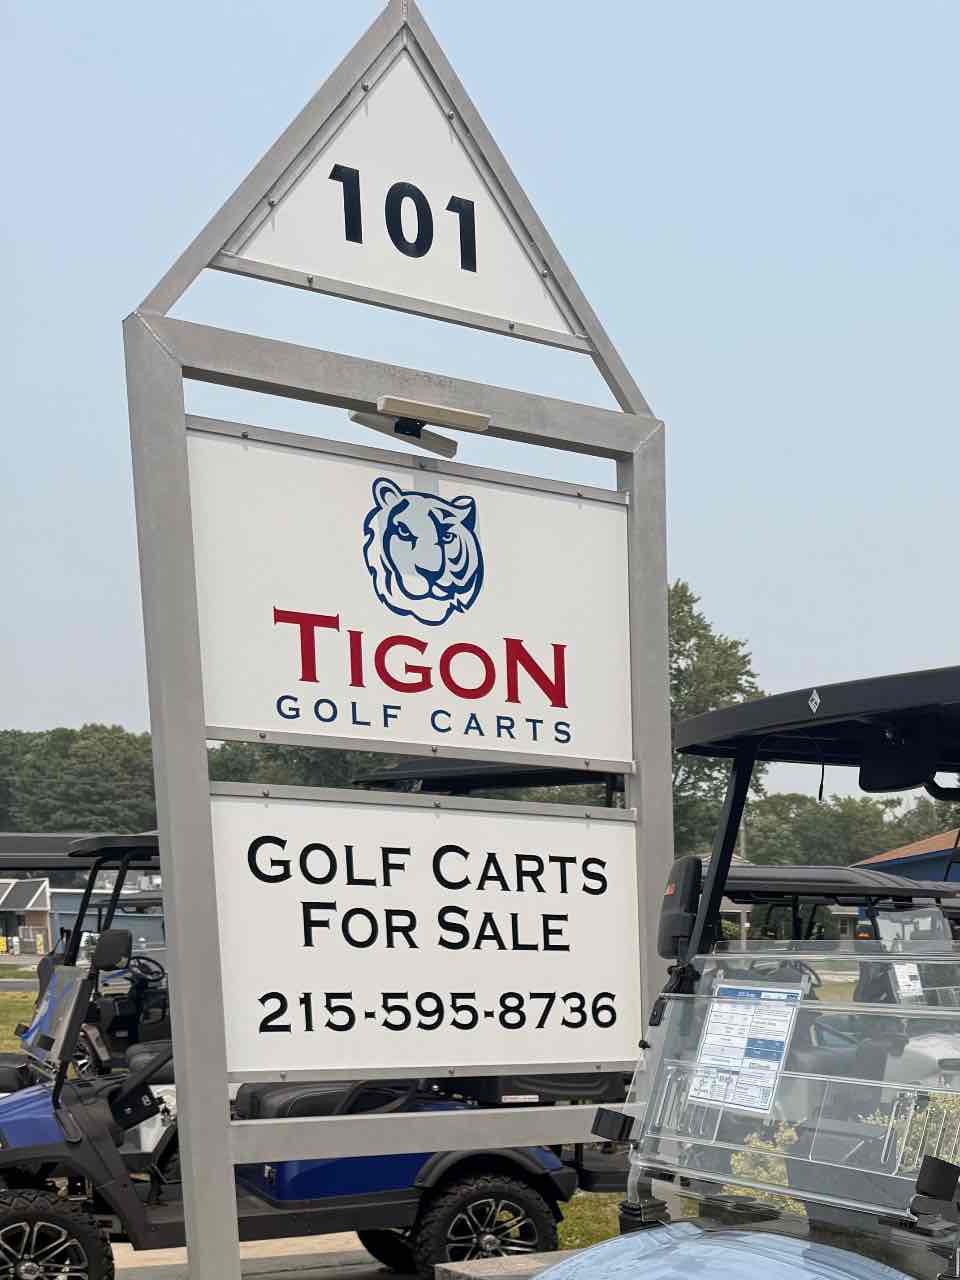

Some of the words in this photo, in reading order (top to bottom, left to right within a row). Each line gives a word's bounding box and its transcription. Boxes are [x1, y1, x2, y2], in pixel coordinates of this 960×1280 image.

[328, 163, 477, 273] 101
[272, 606, 569, 709] TIGON
[276, 694, 402, 728] GOLF
[430, 709, 572, 744] CARTS
[247, 835, 411, 887] GOLF
[432, 844, 608, 896] CARTS
[300, 900, 419, 949] FOR
[437, 905, 570, 952] SALE
[257, 991, 617, 1033] 215-595-8736
